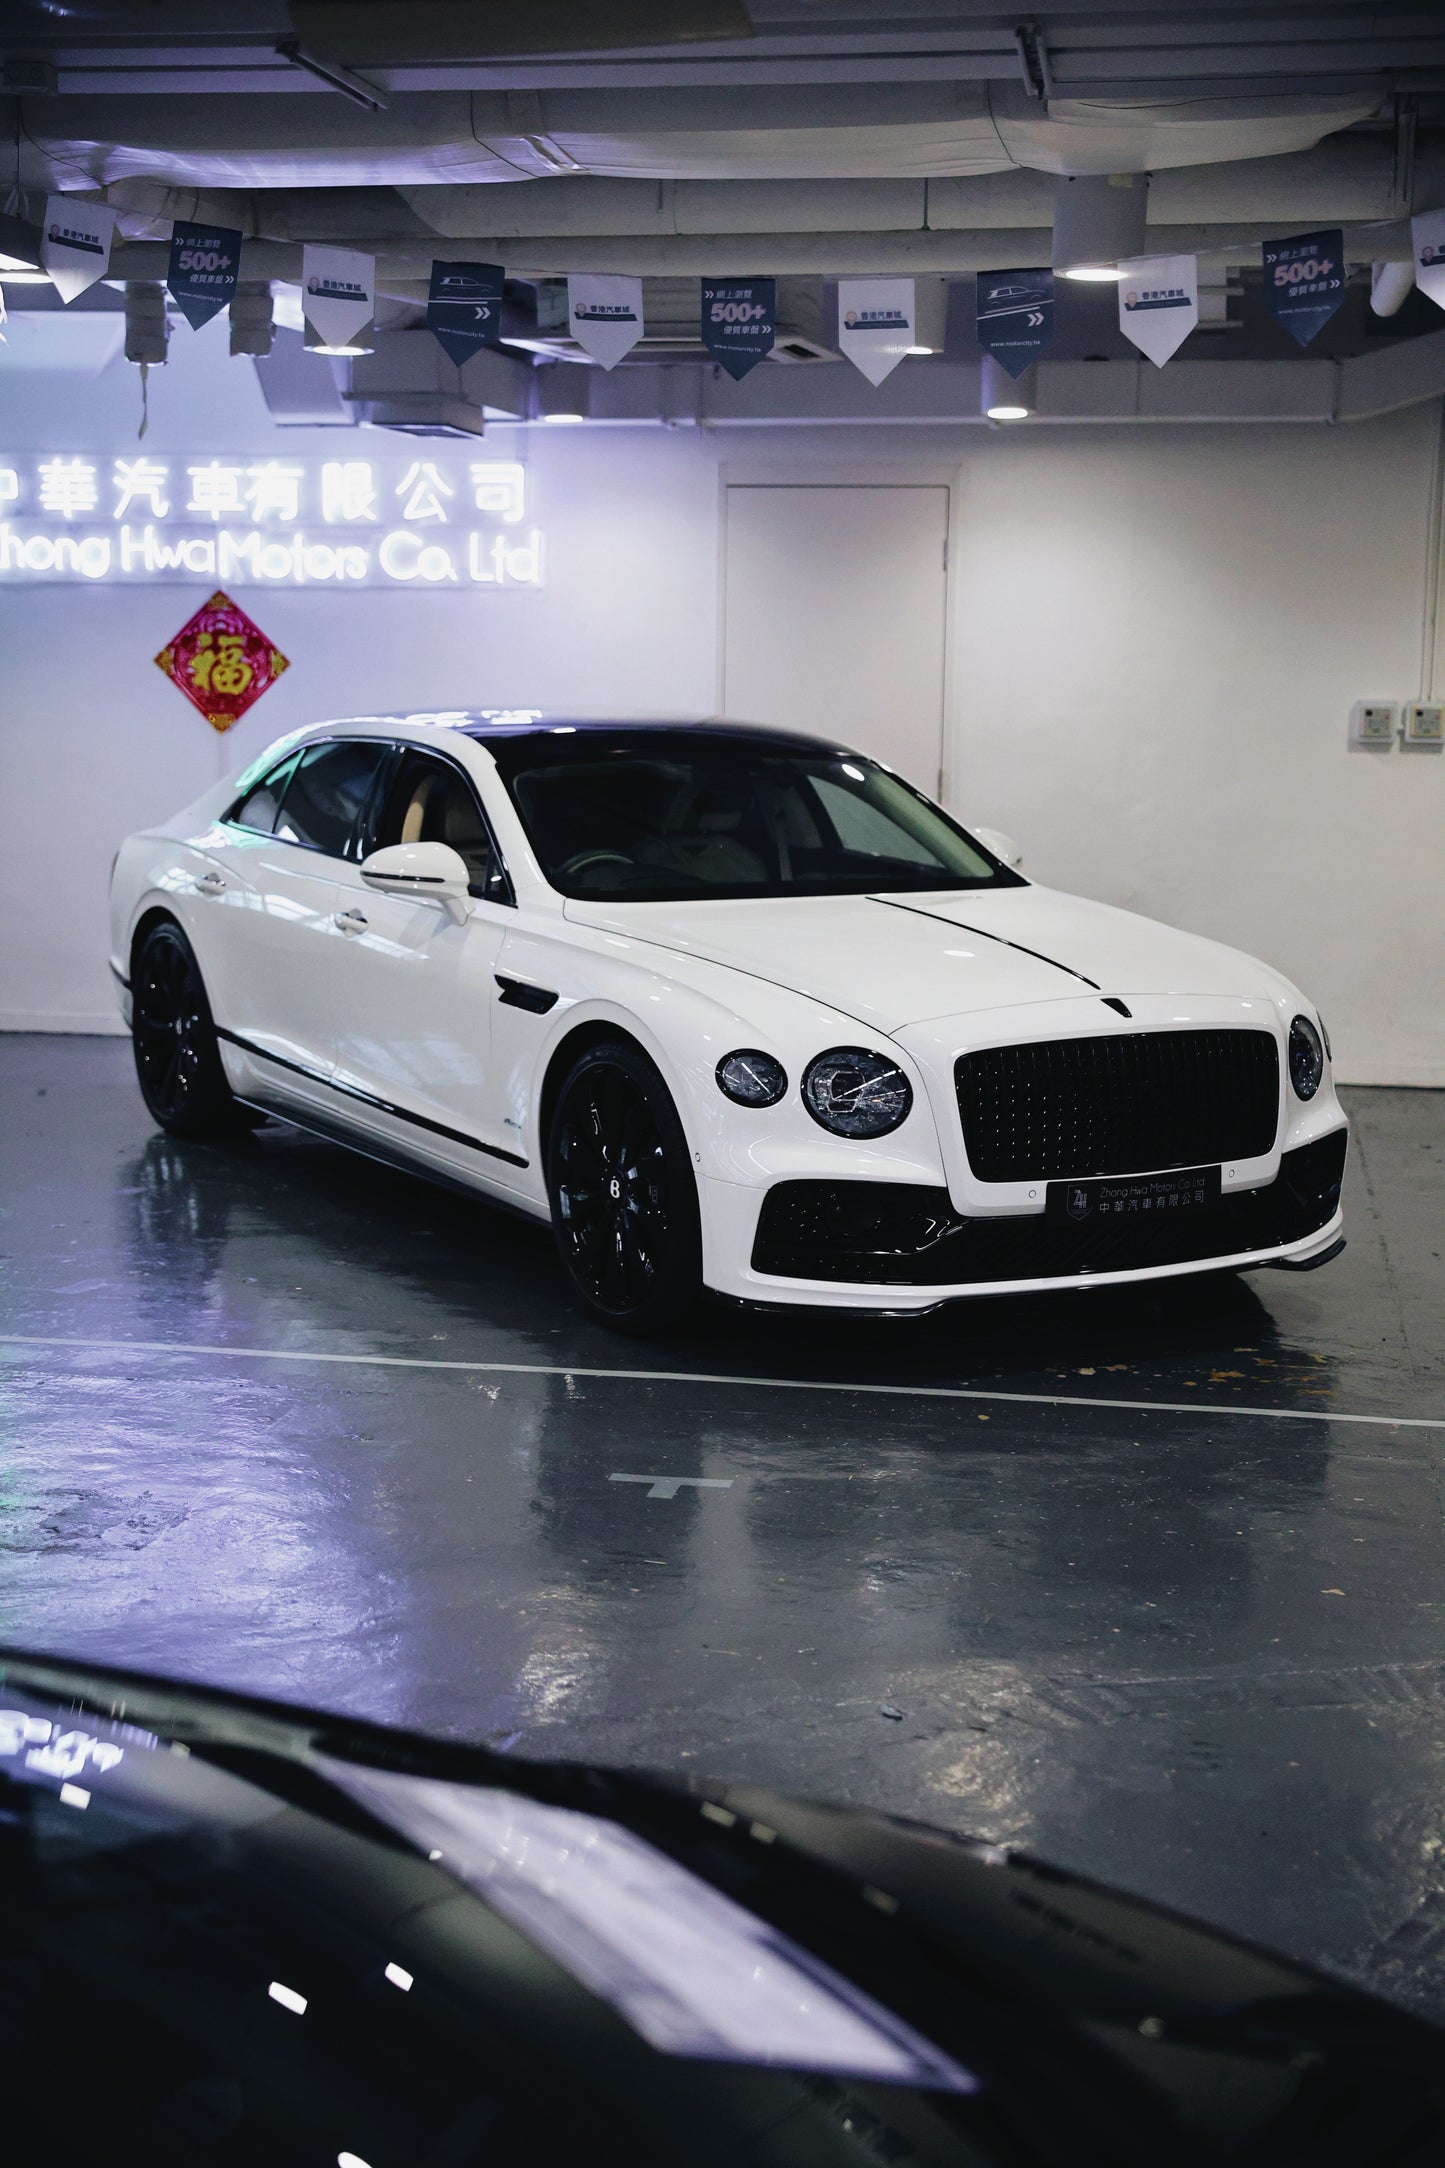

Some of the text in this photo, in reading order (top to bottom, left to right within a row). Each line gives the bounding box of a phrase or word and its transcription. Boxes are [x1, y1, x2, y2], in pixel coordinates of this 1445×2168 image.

[178, 250, 231, 271] 500+
[1274, 258, 1333, 286] 500+
[323, 280, 361, 292] 香港汽車城
[1142, 288, 1184, 300] 香港汽車城
[590, 305, 630, 313] 香港汽車城
[710, 302, 767, 323] 500+
[861, 310, 902, 320] 香港汽車城
[121, 525, 215, 572] Hwa
[218, 530, 369, 581] Motors
[469, 529, 541, 584] Ltd
[190, 632, 254, 695] 福
[1100, 1187, 1128, 1198] Zhong
[1130, 1185, 1148, 1195] Hwa
[1150, 1182, 1176, 1194] Motors
[1099, 1190, 1204, 1214] 中華汽車有限公司
